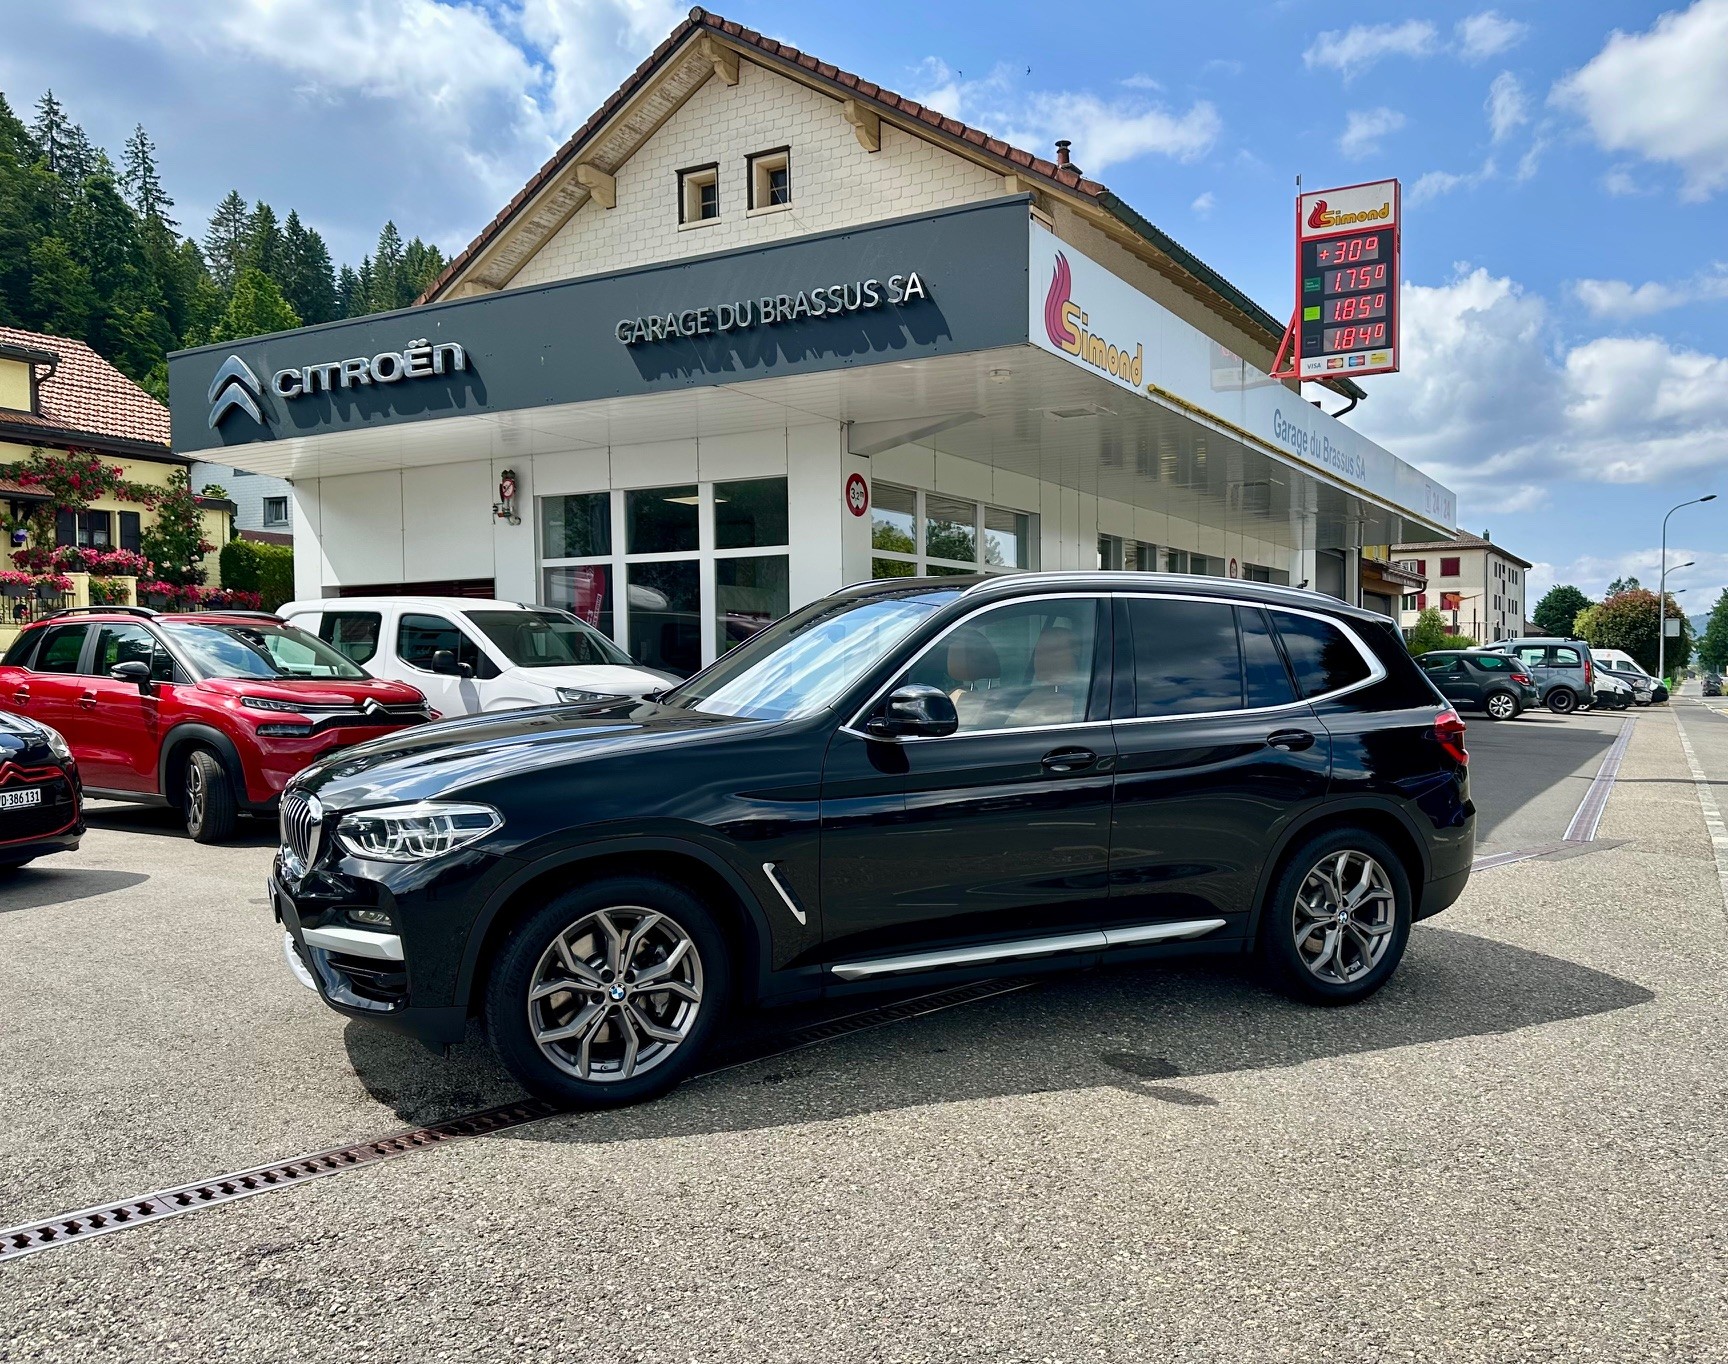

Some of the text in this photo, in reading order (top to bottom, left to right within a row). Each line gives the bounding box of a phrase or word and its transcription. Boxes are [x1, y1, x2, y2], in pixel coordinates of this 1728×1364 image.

[1321, 203, 1390, 227] Simond
[614, 271, 925, 344] GARAGE DU BRASSUS SA
[1061, 299, 1143, 387] Simond
[1307, 362, 1321, 370] VISA
[1273, 408, 1366, 482] Garage du Brassus SA
